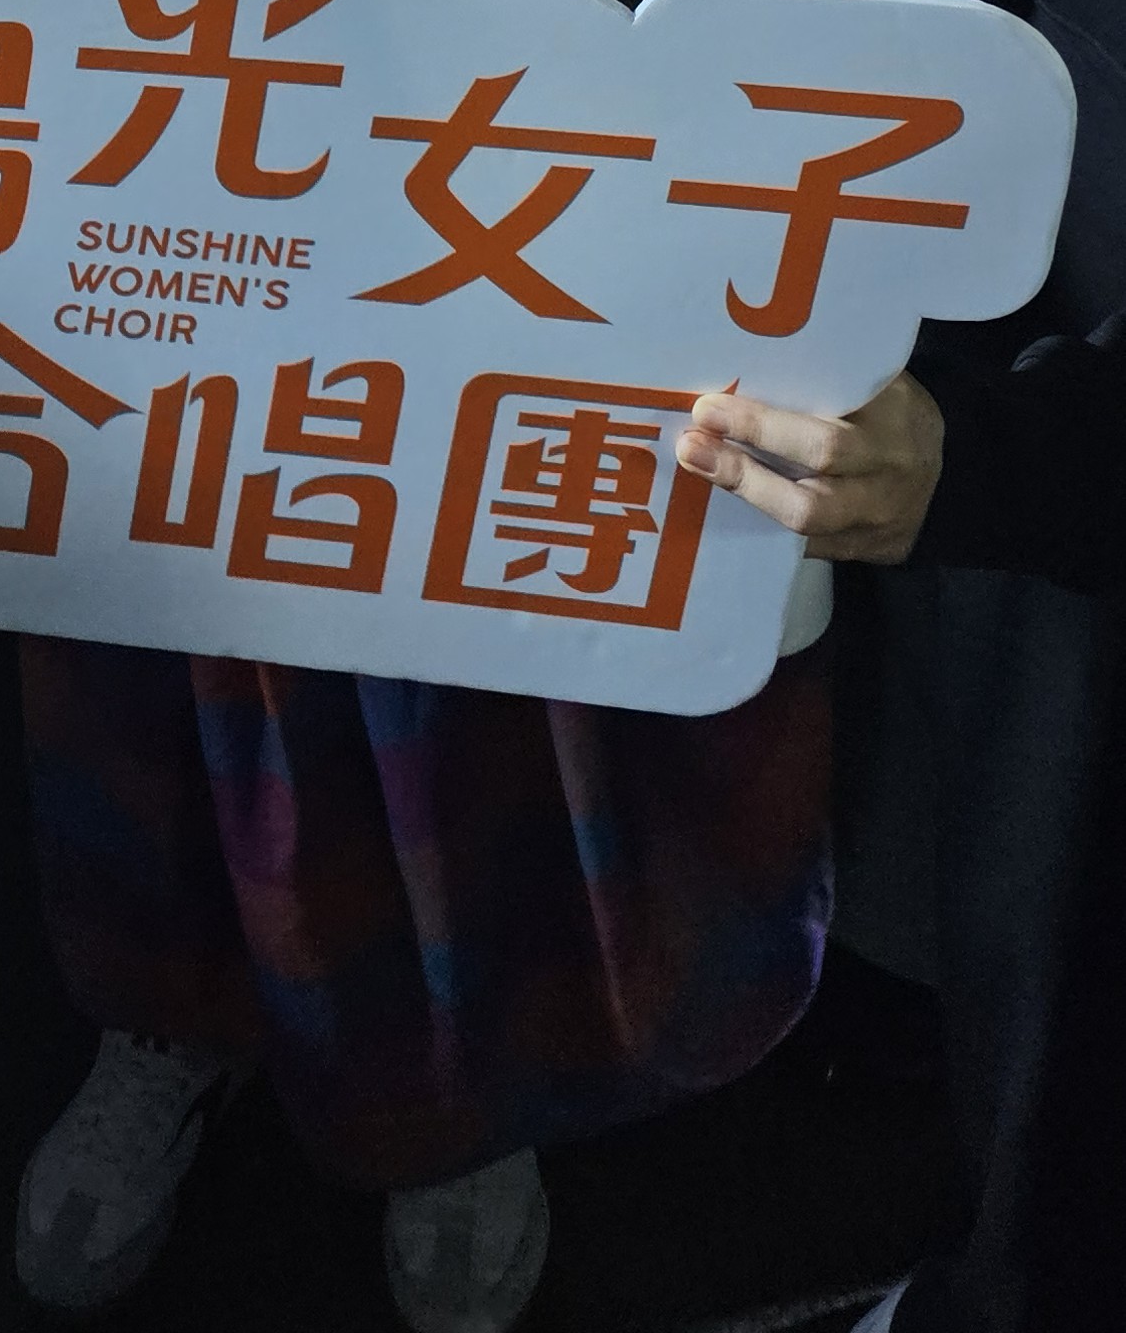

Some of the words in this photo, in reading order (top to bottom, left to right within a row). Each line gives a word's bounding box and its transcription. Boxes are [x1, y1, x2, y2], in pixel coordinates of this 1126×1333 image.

[76, 220, 315, 270] SUNSHINE
[68, 261, 290, 310] WOMEN'S
[54, 303, 197, 345] CHOIR
